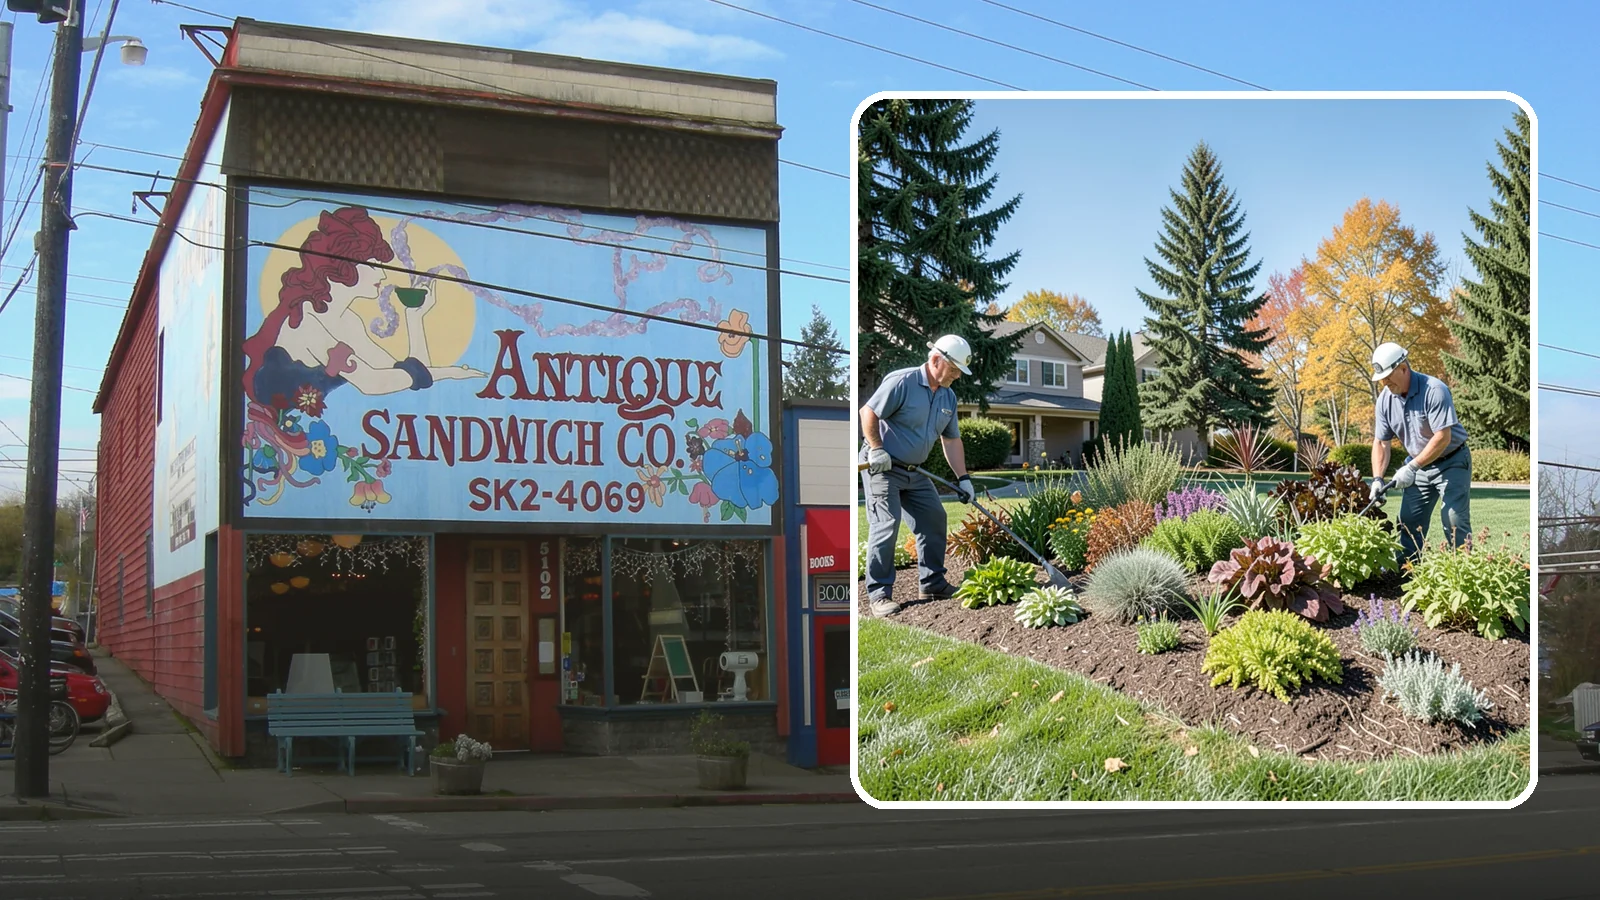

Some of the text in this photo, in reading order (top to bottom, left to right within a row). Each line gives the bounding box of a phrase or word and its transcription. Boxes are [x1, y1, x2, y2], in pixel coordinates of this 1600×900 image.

[476, 329, 723, 421] ANTIQUE
[361, 408, 685, 468] SANDWICH CO.
[468, 477, 645, 513] SK2-4069
[539, 542, 552, 600] 5102
[809, 555, 835, 569] BOOKS
